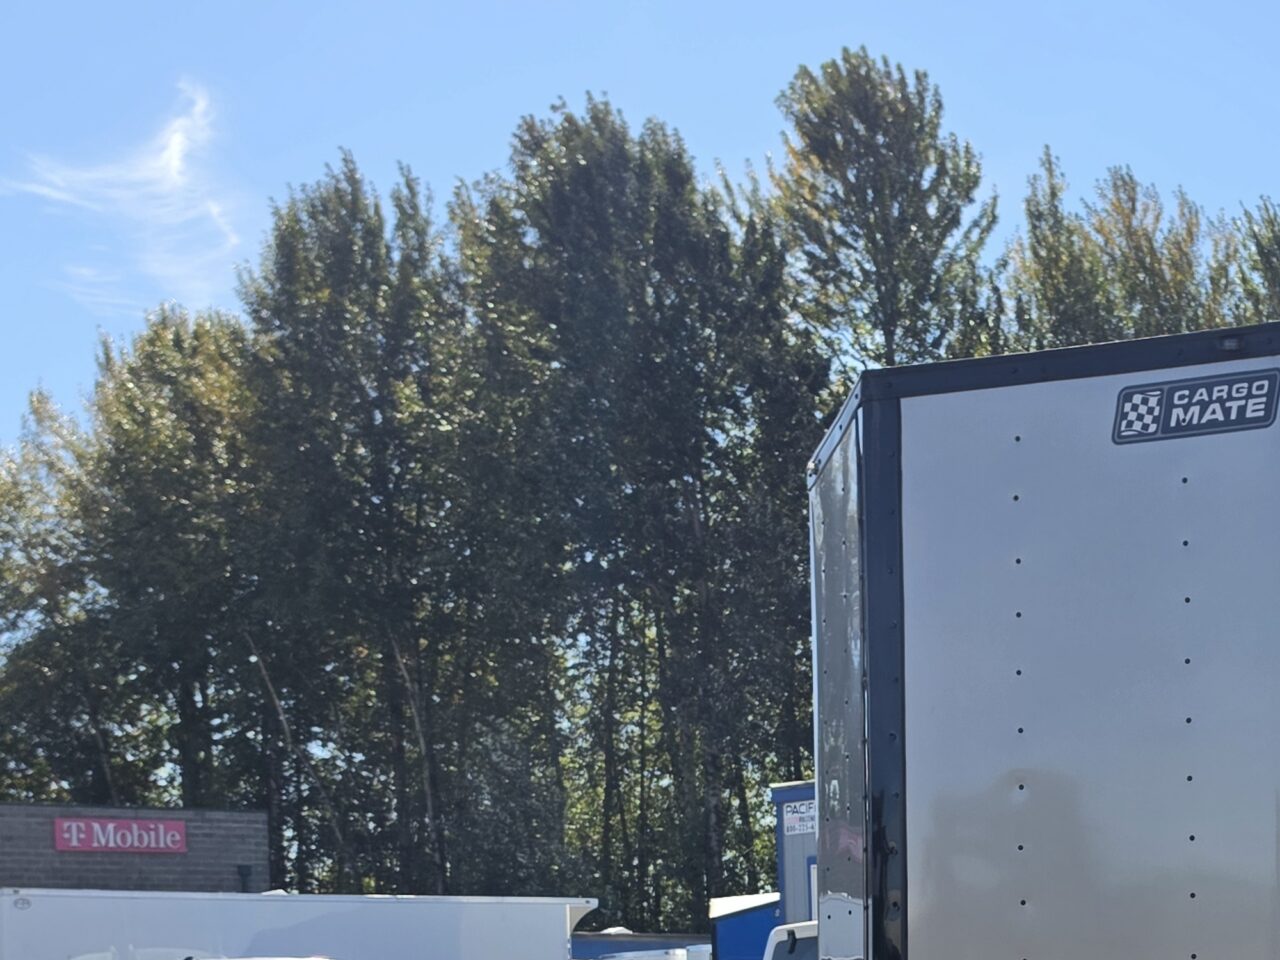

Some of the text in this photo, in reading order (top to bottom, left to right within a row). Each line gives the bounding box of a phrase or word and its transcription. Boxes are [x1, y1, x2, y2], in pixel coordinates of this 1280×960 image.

[1173, 380, 1270, 405] CARGO
[1170, 397, 1267, 427] MATE
[91, 822, 181, 848] Mobile
